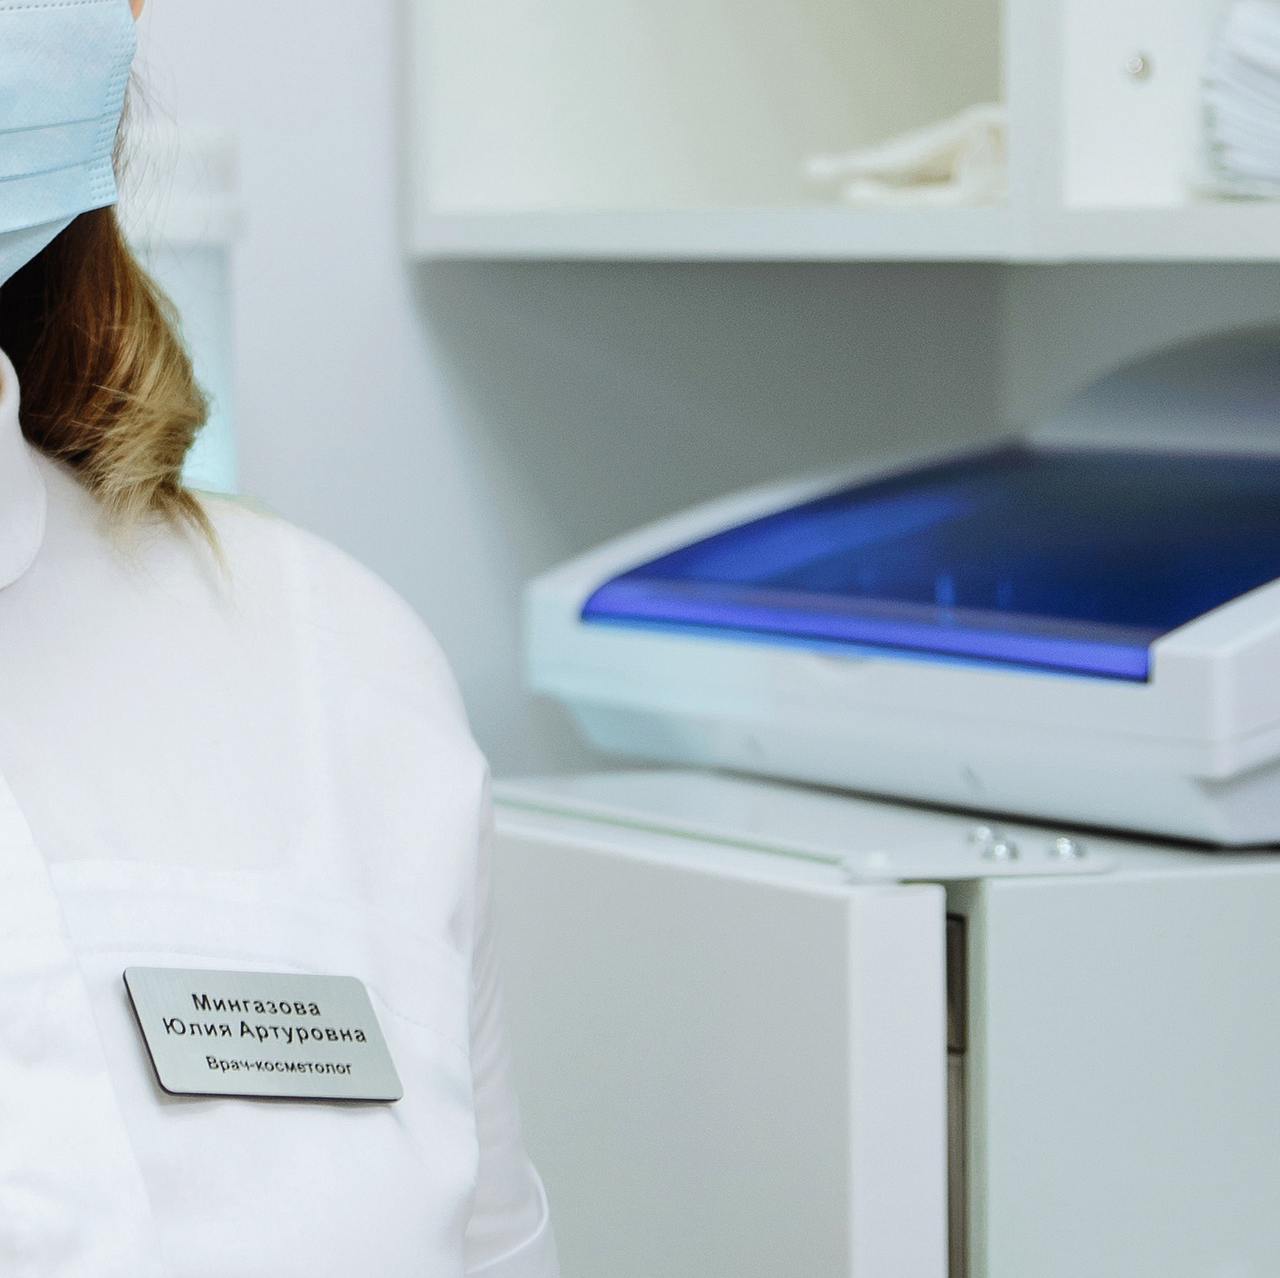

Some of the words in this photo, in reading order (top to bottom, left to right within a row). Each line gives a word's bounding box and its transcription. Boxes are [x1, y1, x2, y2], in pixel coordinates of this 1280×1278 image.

[191, 993, 321, 1017] Мингазова
[162, 1017, 233, 1037] Юлия
[239, 1020, 368, 1044] Артуровна
[205, 1055, 353, 1075] Врач-косметолог
